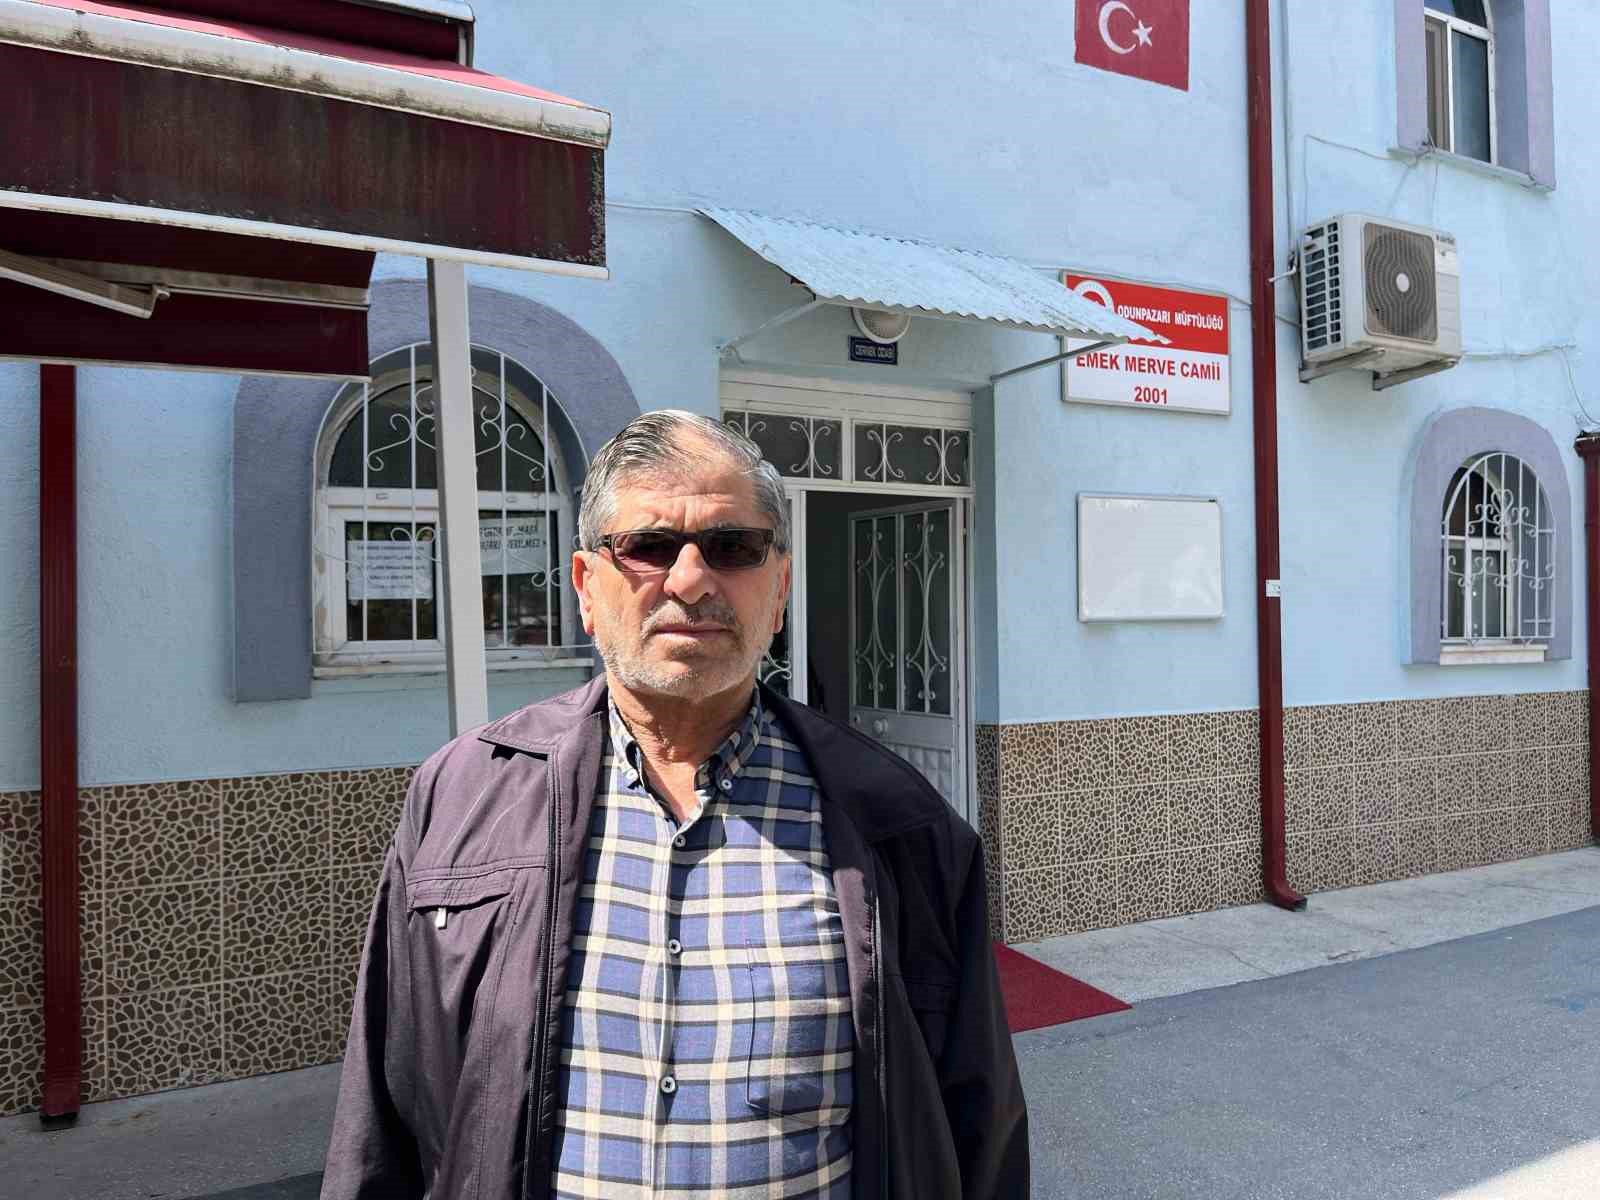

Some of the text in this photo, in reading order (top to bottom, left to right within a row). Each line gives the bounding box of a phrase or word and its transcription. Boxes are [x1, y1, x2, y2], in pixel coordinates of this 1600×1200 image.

[1117, 305, 1224, 331] ODUNPAZARI MÜFTÜLÜĞÜ
[1076, 352, 1220, 380] EMEK MERVE CAMİİ
[1134, 386, 1168, 404] 2001
